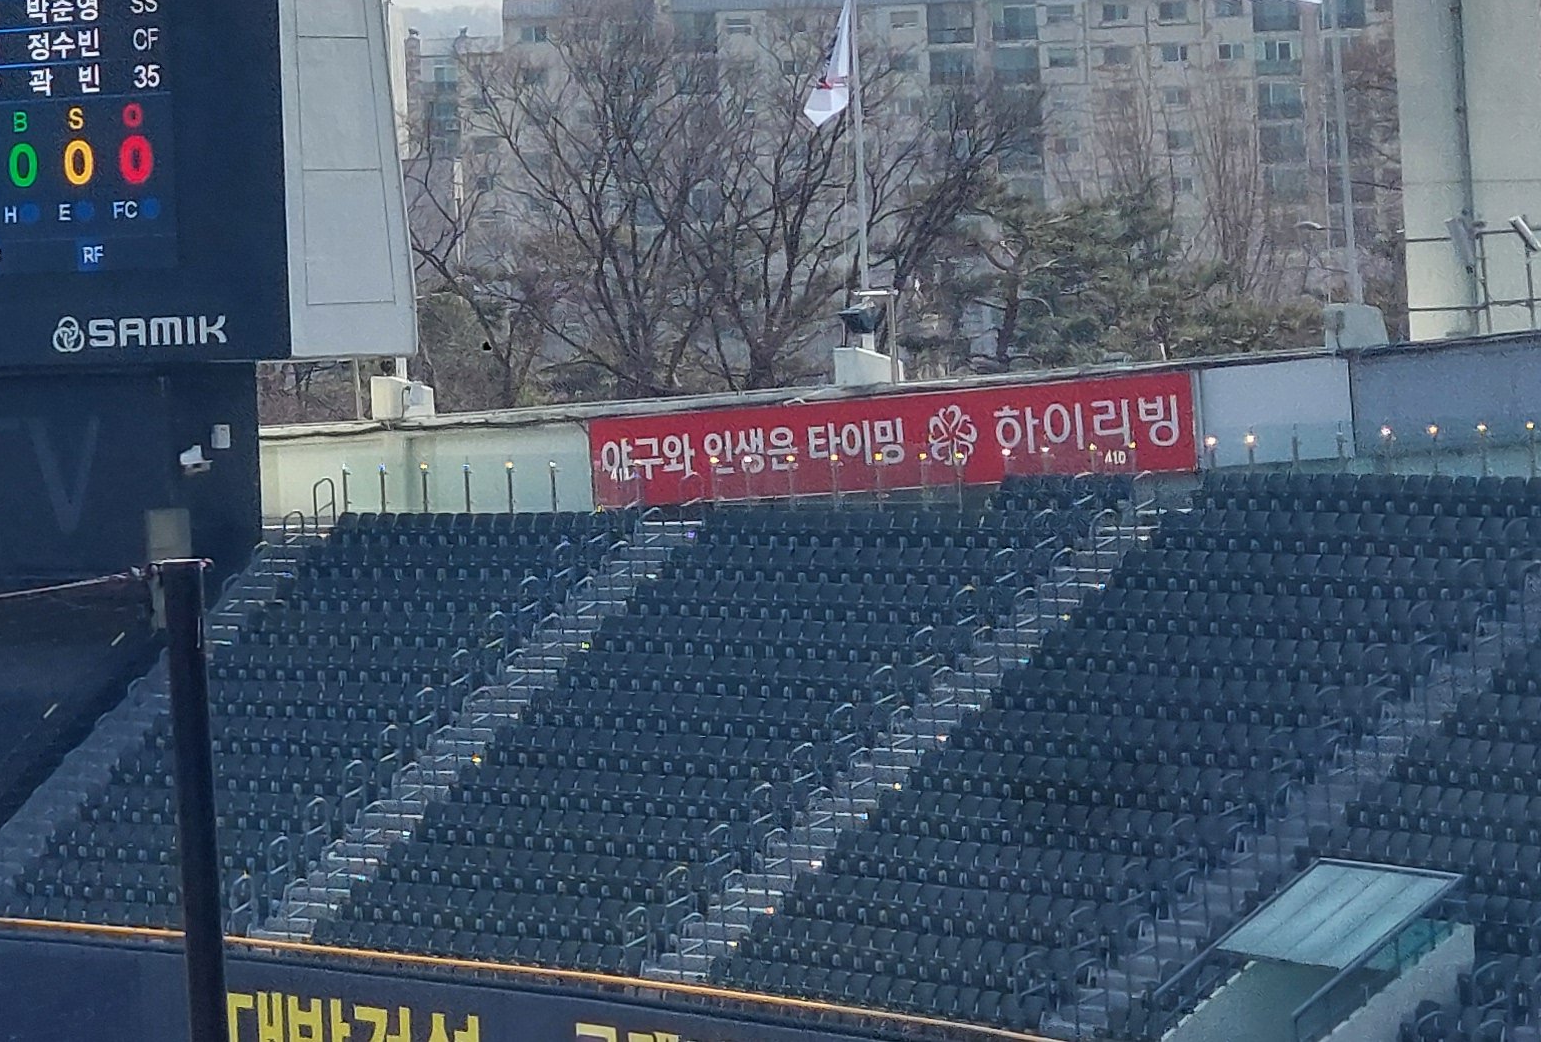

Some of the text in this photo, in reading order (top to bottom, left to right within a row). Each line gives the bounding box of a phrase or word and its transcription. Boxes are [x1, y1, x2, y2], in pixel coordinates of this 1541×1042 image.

[28, 28, 160, 60] 정수빈 CF
[134, 65, 160, 88] 35
[14, 108, 83, 132] B S
[9, 135, 152, 187] 0 0 0
[113, 201, 137, 219] FC
[82, 246, 103, 263] RF
[89, 315, 227, 347] SAMIK
[994, 394, 1178, 456] 하이리빙
[601, 419, 906, 480] 야구와 인생은 타이밍
